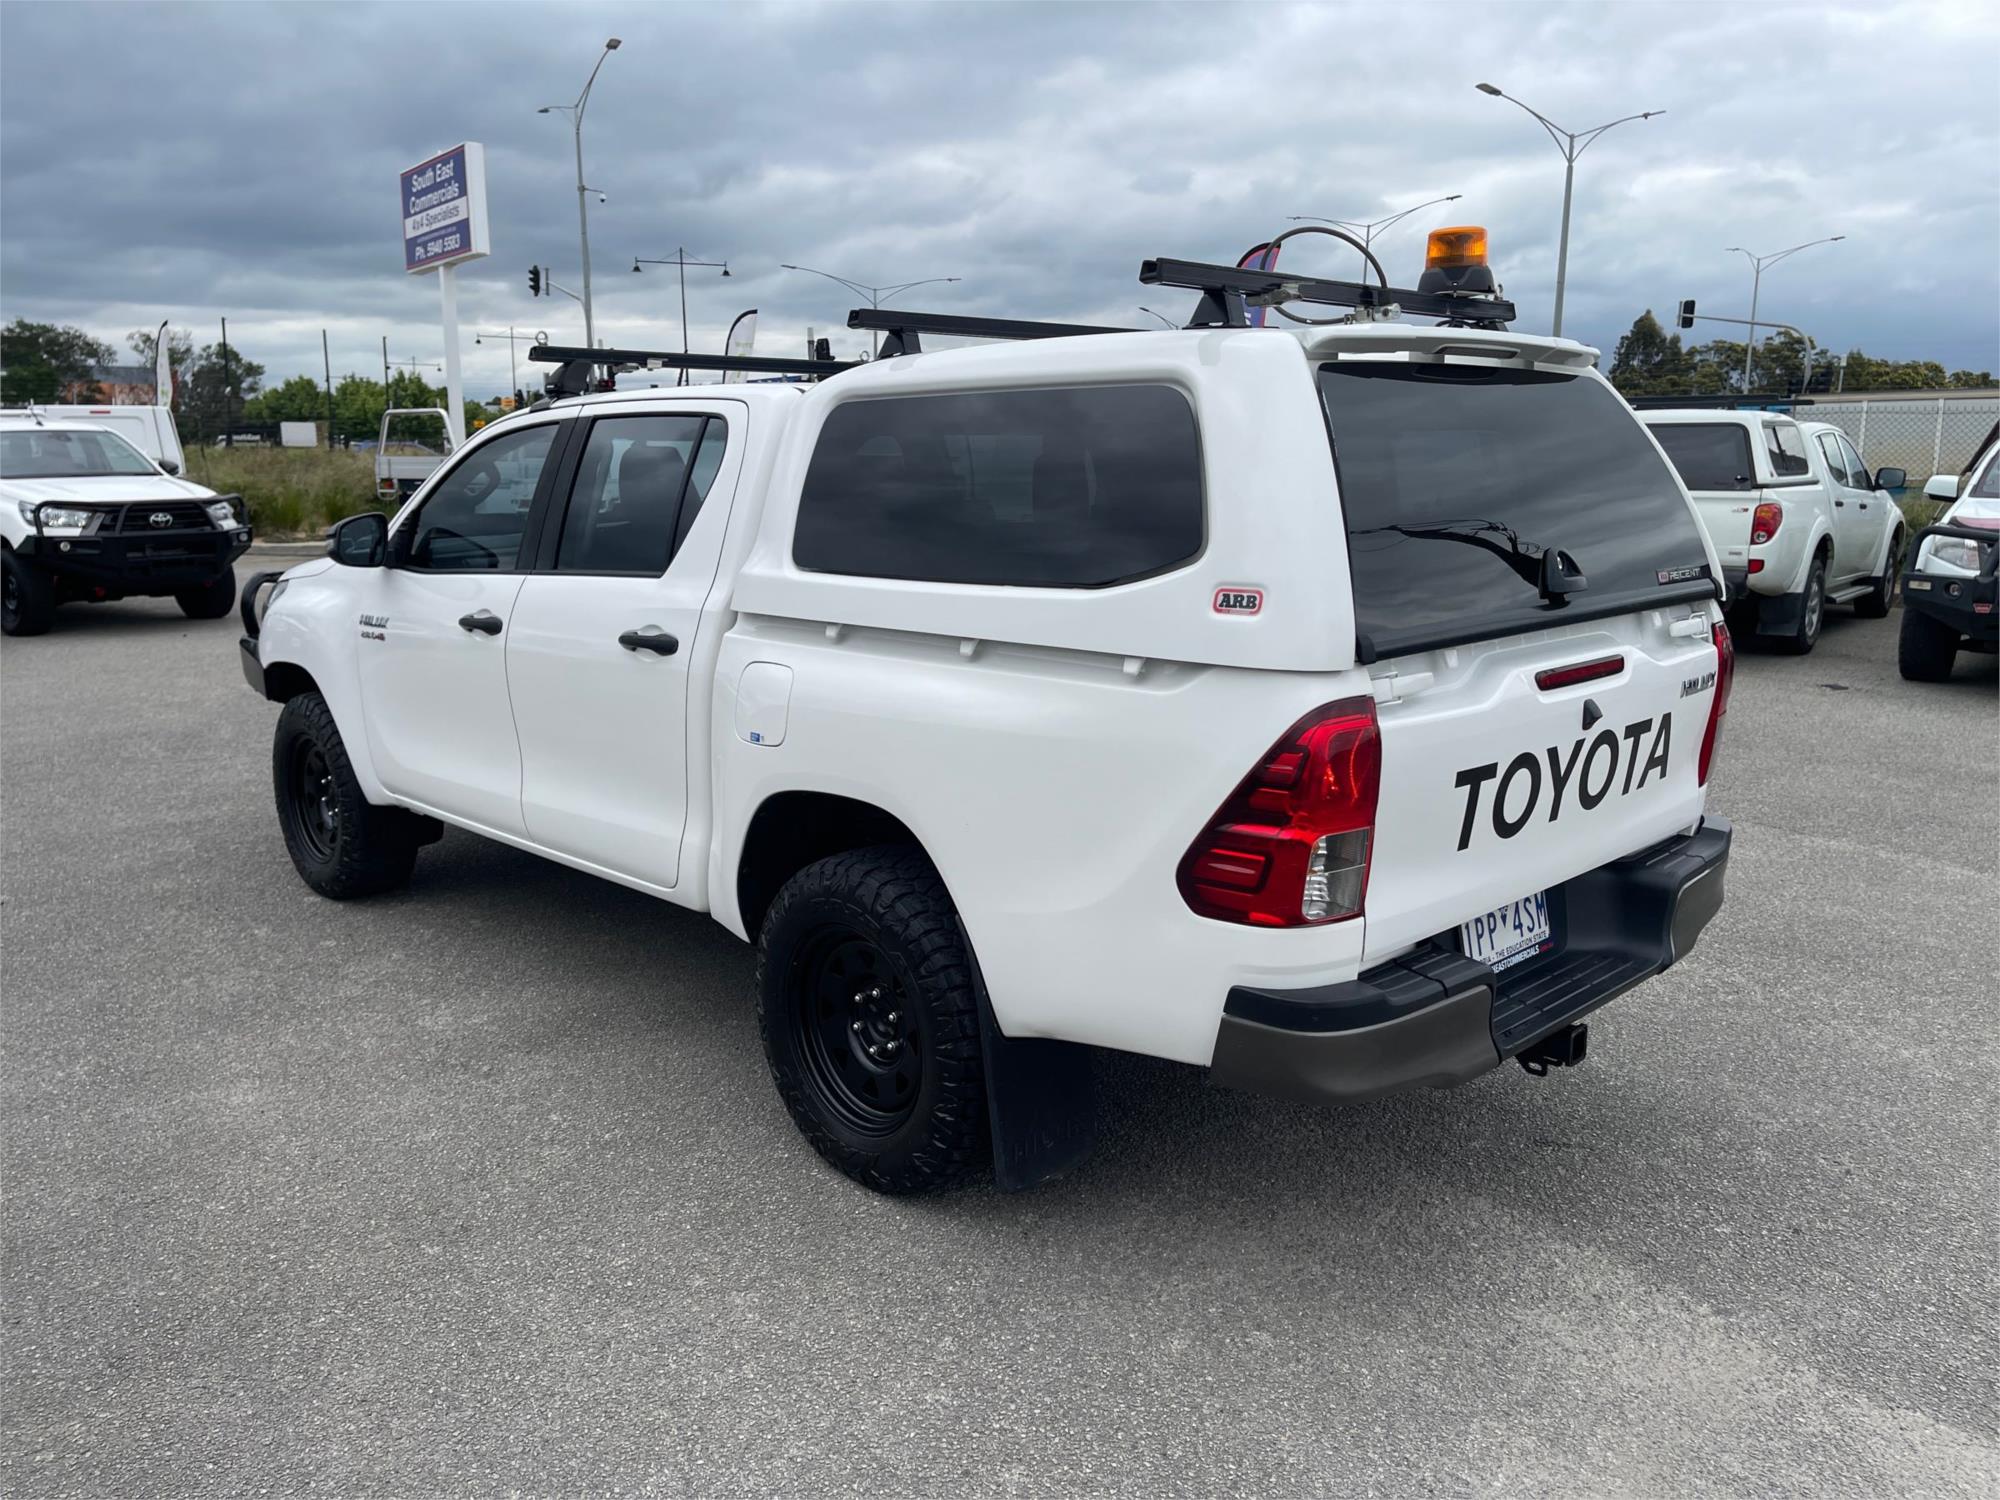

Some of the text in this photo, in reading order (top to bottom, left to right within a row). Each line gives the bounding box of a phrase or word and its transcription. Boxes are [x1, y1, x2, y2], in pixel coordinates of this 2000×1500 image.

[411, 159, 454, 193] South East
[409, 180, 460, 214] Commercials
[412, 204, 460, 232] 4x4 Specialists
[1218, 592, 1258, 610] ARB
[1455, 711, 1672, 852] TOYOTA
[1495, 947, 1506, 959] THE
[1506, 936, 1533, 955] EDUCATION
[1533, 930, 1547, 943] STATE
